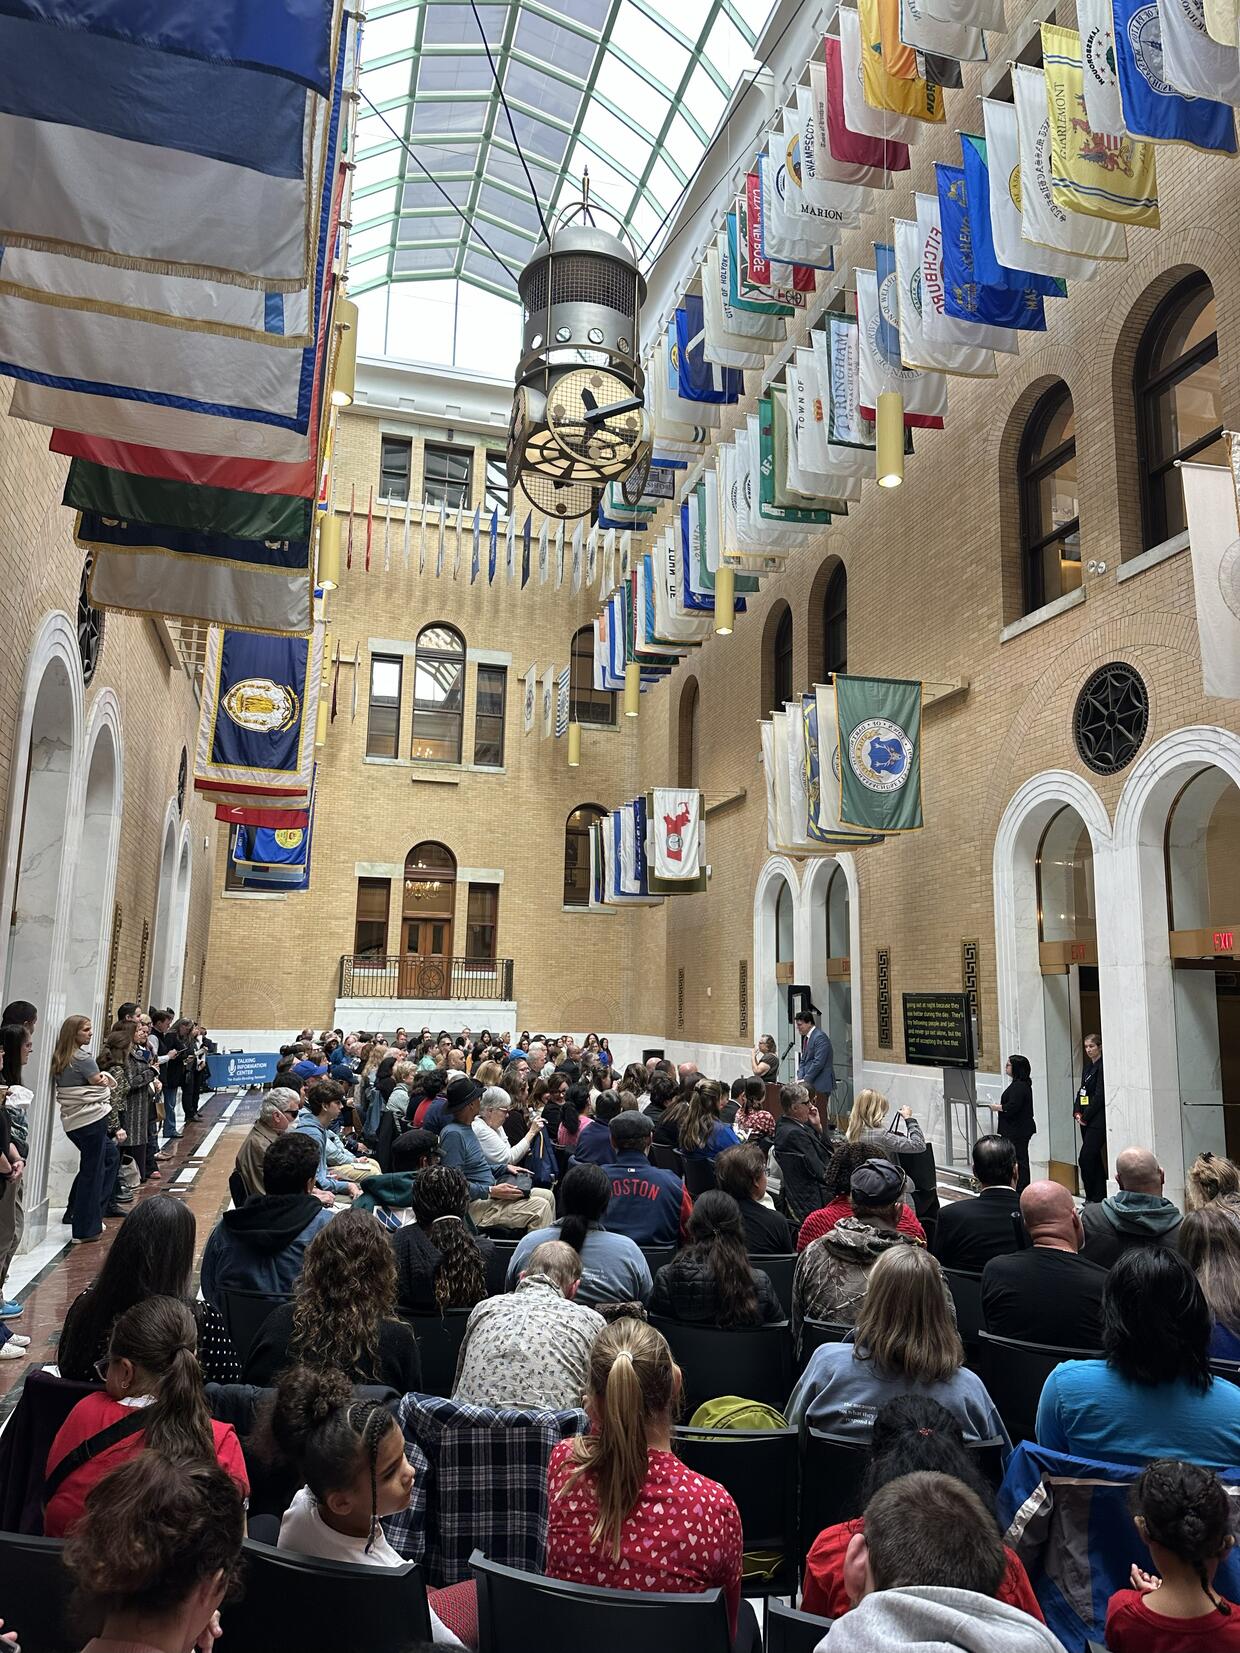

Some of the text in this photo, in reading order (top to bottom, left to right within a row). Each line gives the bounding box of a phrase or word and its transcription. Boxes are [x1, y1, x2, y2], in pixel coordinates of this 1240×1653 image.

[801, 204, 843, 221] MARION
[721, 286, 728, 297] OF
[797, 380, 805, 392] OF
[834, 331, 850, 433] TYRINGHAM
[1213, 932, 1234, 952] EXIT
[612, 1178, 660, 1201] OSTON
